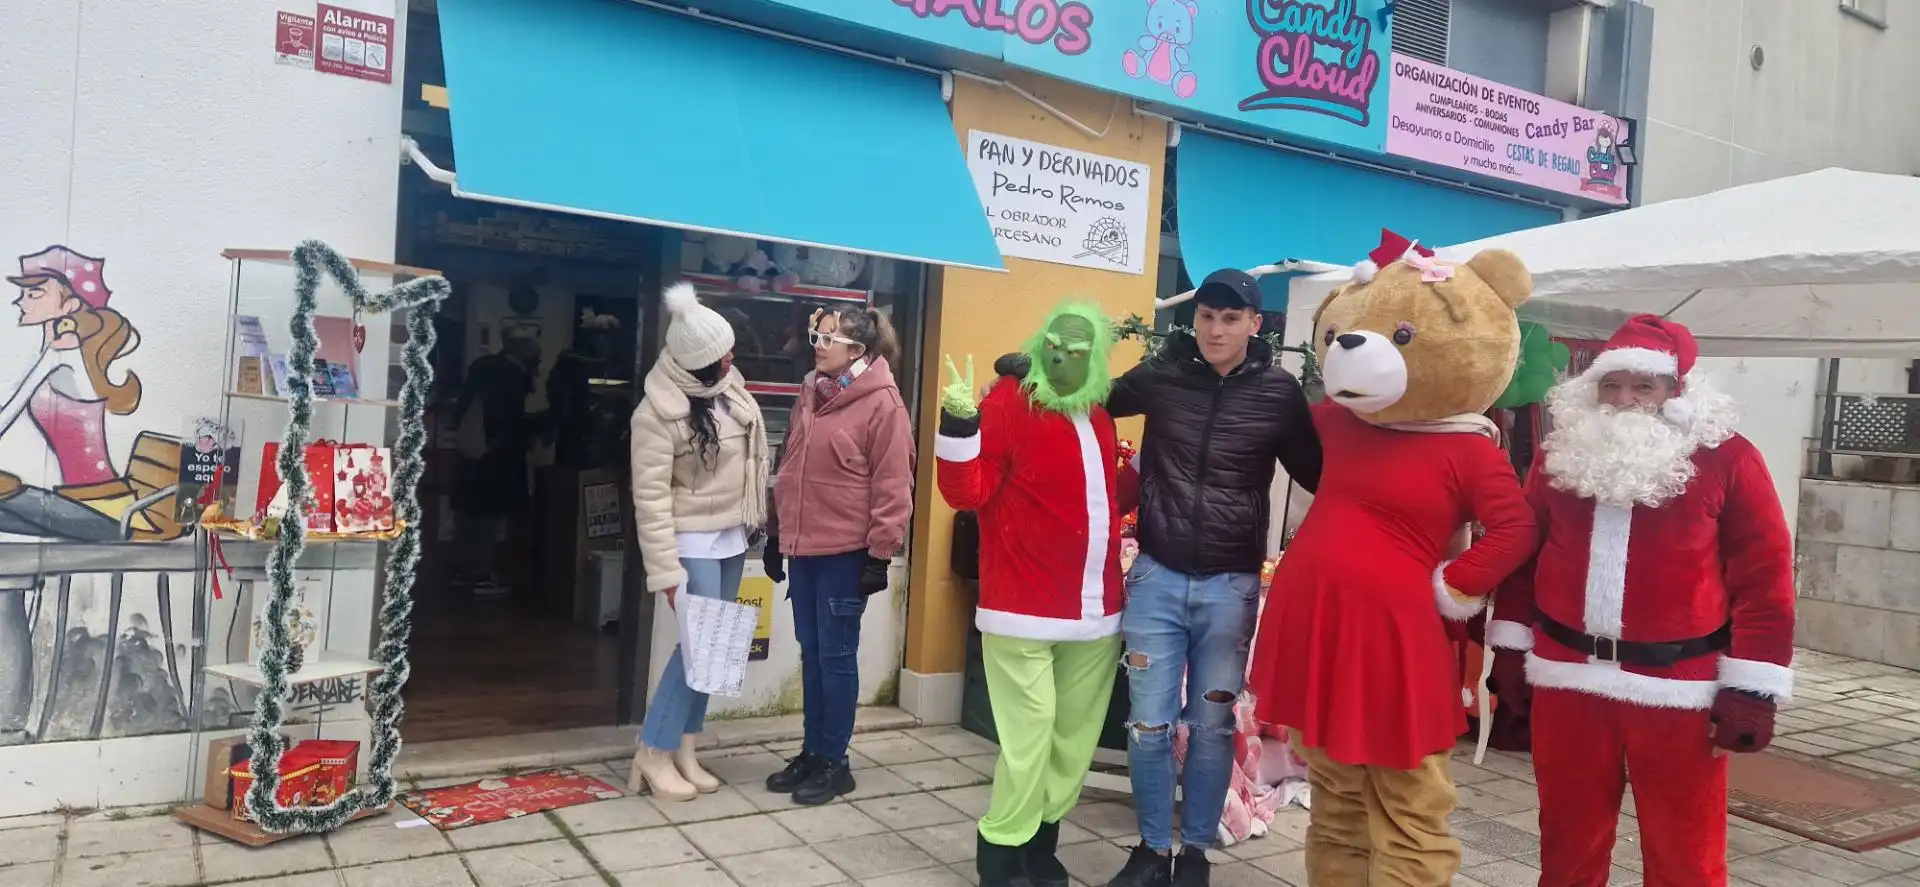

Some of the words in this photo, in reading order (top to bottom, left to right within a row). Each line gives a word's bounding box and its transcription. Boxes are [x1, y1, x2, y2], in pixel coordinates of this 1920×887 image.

[323, 9, 388, 35] Alarma
[337, 28, 356, 37] aviso
[1249, 0, 1369, 69] Candy
[1260, 33, 1377, 103] Cloud
[1395, 62, 1478, 97] ORGANIZACIÓN
[1481, 87, 1496, 103] DE
[1498, 91, 1540, 116] EVENTOS
[1415, 103, 1467, 124] ANIVERSARIOS
[1474, 117, 1520, 138] COMUNIONES
[1429, 93, 1478, 116] CUMPLEAÑOS
[1485, 108, 1508, 123] BODAS
[1392, 115, 1442, 141] Desayunos
[1445, 132, 1452, 142] a
[1453, 134, 1495, 153] Domicilio
[1525, 118, 1569, 140] Candy
[1572, 115, 1596, 133] Bar
[979, 138, 1015, 166] PAN
[1022, 146, 1033, 167] Y
[1039, 150, 1141, 188] DERIVADOS
[1463, 156, 1469, 165] y
[1470, 155, 1498, 170] mucho
[1506, 143, 1535, 165] CESTAS
[1538, 153, 1549, 169] DE
[1552, 155, 1581, 176] REGALO
[992, 171, 1054, 198] Pedro
[1060, 184, 1125, 213] Ramos
[986, 206, 995, 217] L
[1001, 209, 1068, 229] OBRADOR
[994, 227, 1062, 247] RTESANO
[187, 464, 231, 473] espeo
[195, 452, 210, 462] Yo
[195, 473, 214, 483] aq
